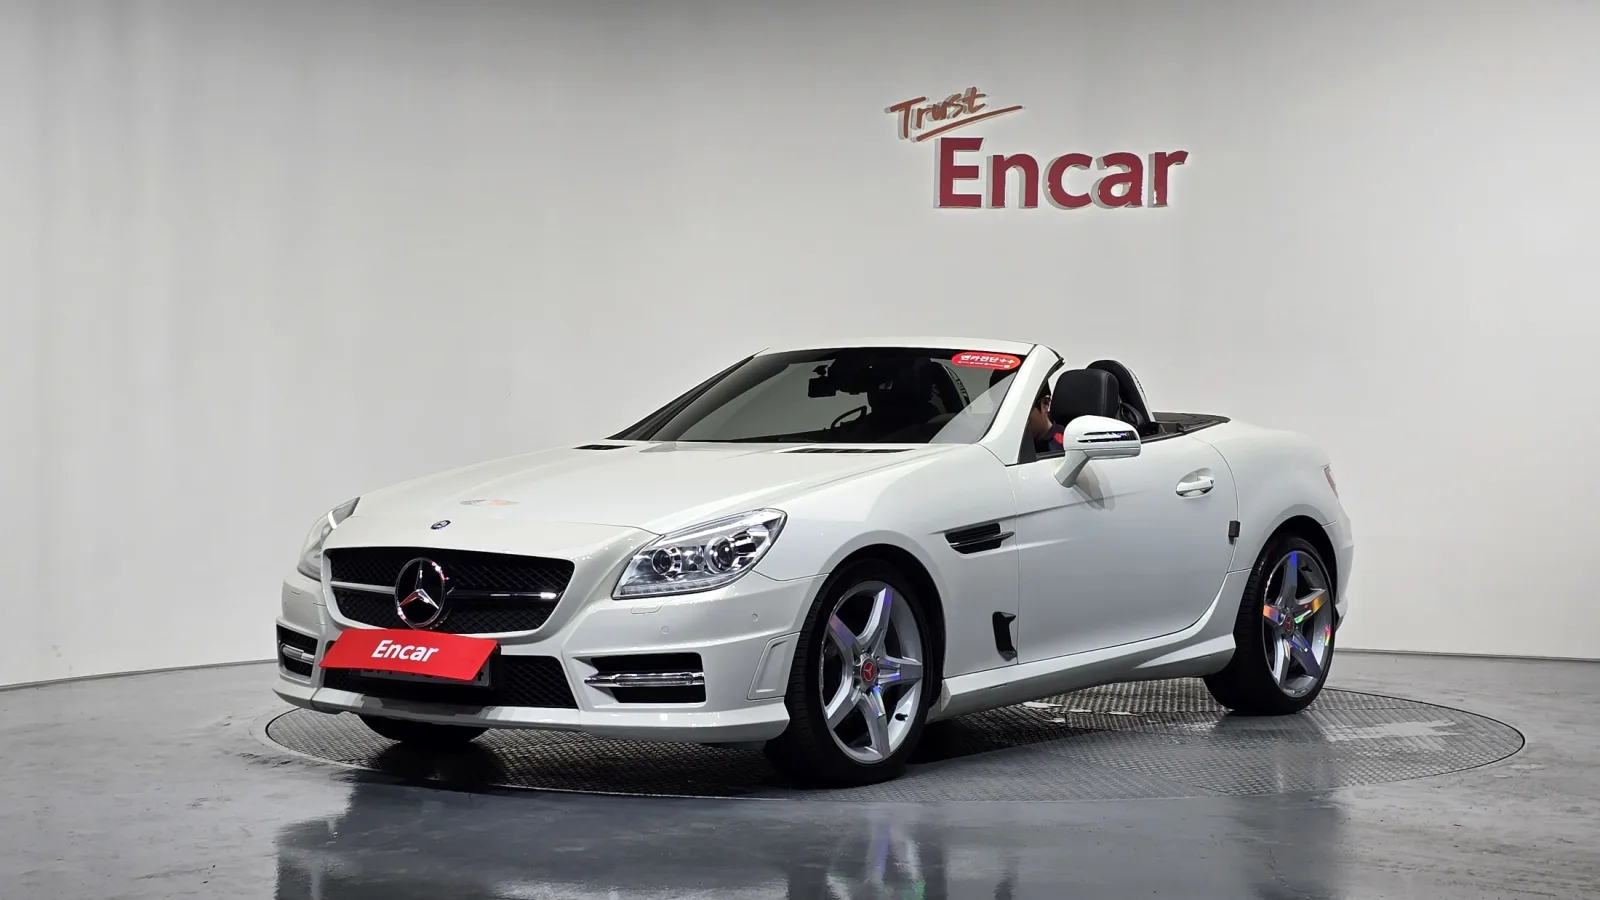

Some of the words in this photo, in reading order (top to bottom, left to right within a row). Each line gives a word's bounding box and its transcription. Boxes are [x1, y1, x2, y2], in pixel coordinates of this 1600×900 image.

[888, 86, 987, 139] Trust
[937, 137, 1189, 209] Encar
[371, 639, 439, 662] Encar
